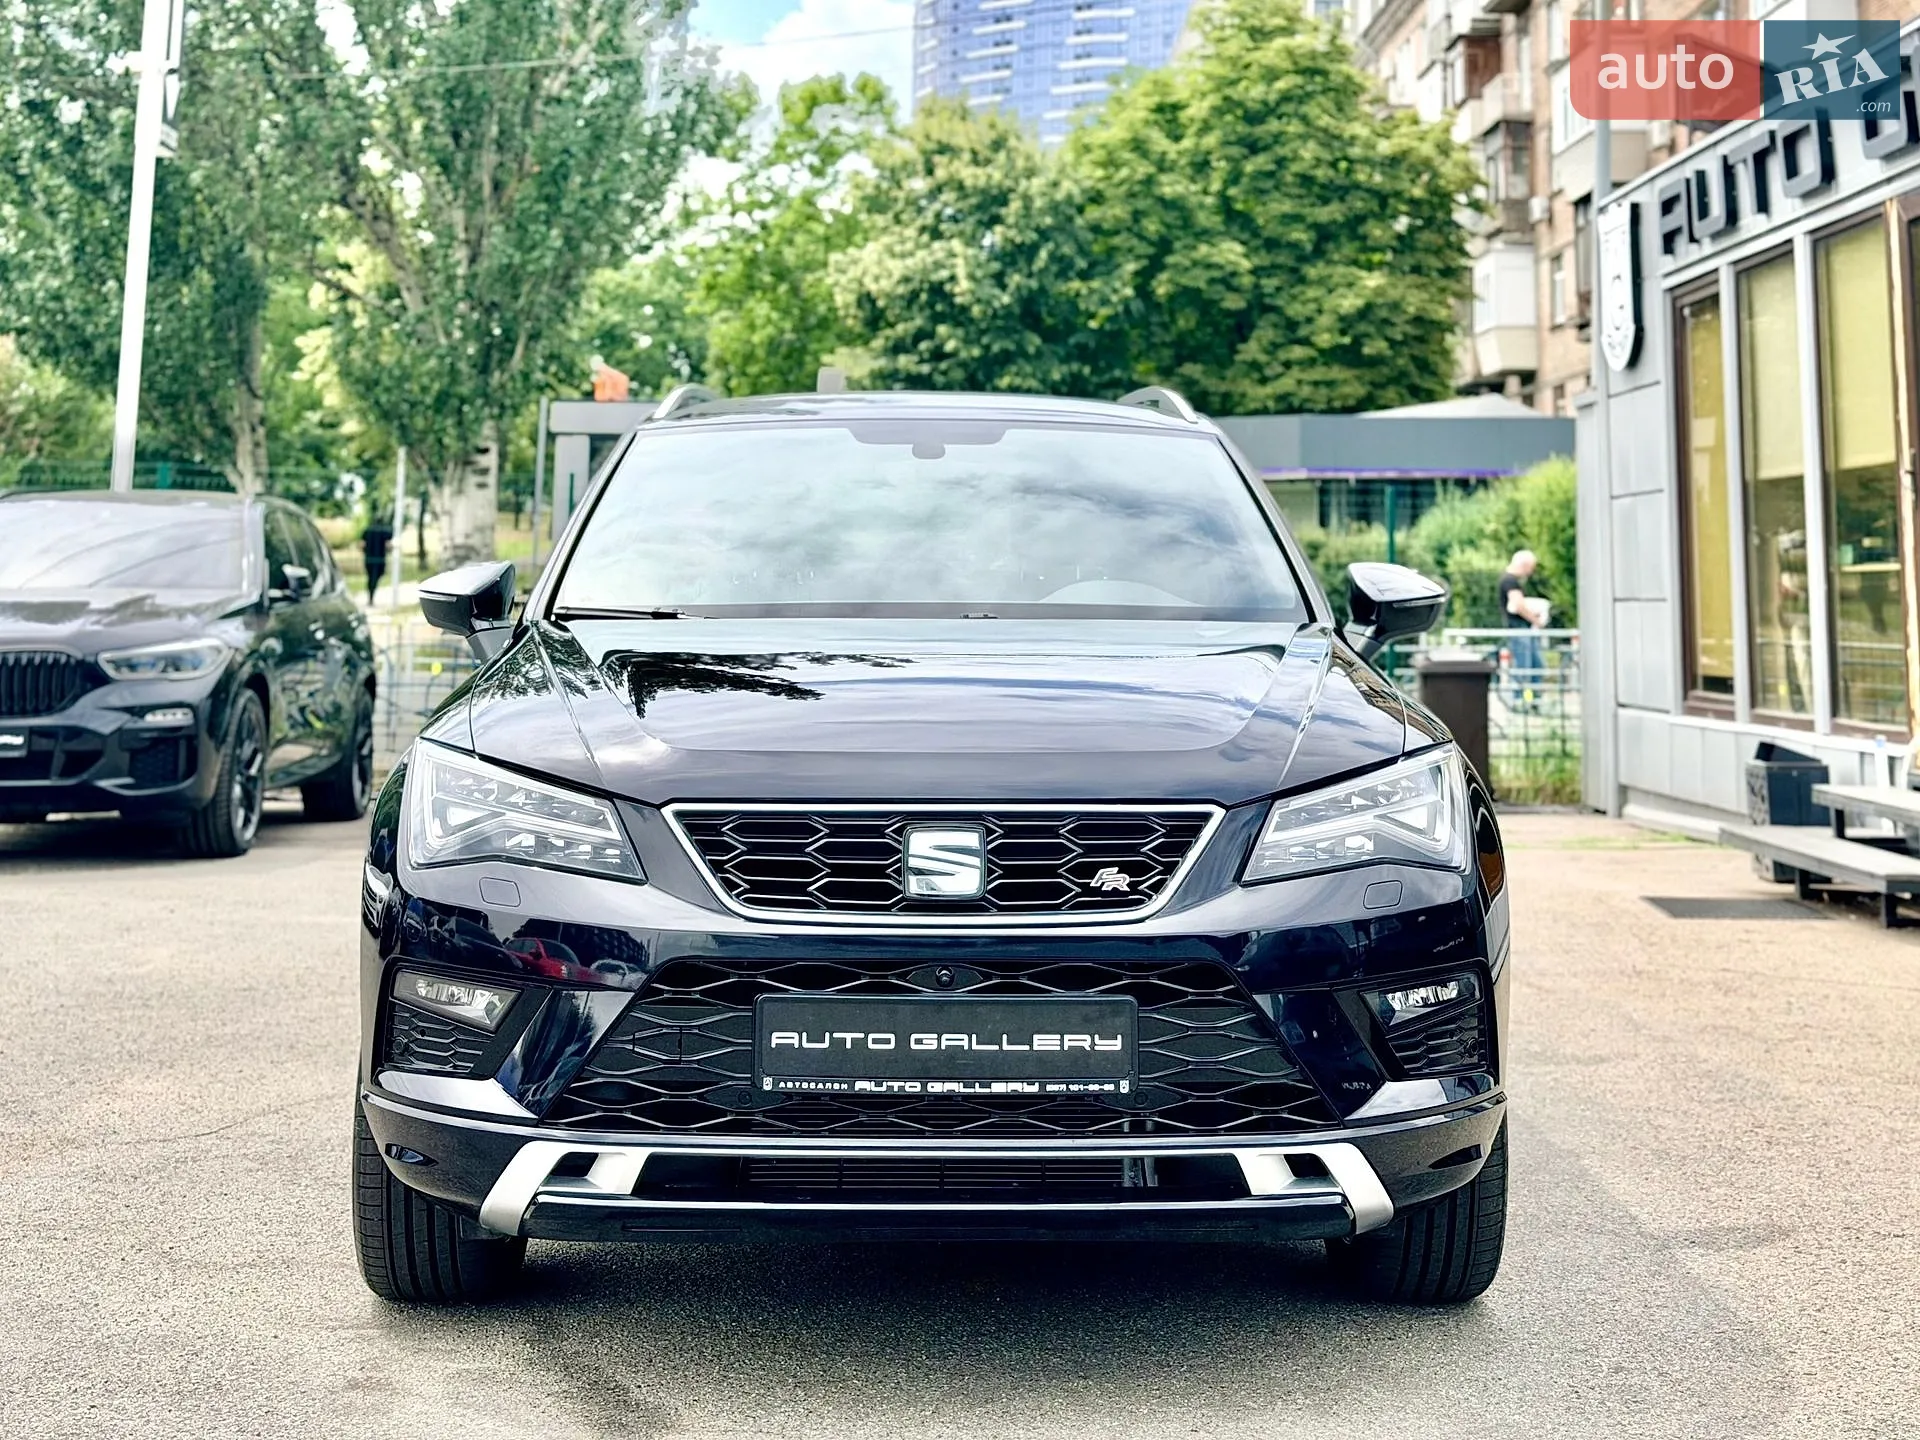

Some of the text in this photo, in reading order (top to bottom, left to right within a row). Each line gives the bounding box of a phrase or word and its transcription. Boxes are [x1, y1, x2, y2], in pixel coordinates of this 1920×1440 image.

[1658, 108, 1837, 256] AUTO
[1090, 867, 1130, 891] FR
[770, 1031, 1122, 1051] AUTO GALLERY
[854, 1080, 921, 1092] AUTO
[927, 1081, 1039, 1093] GALLERY
